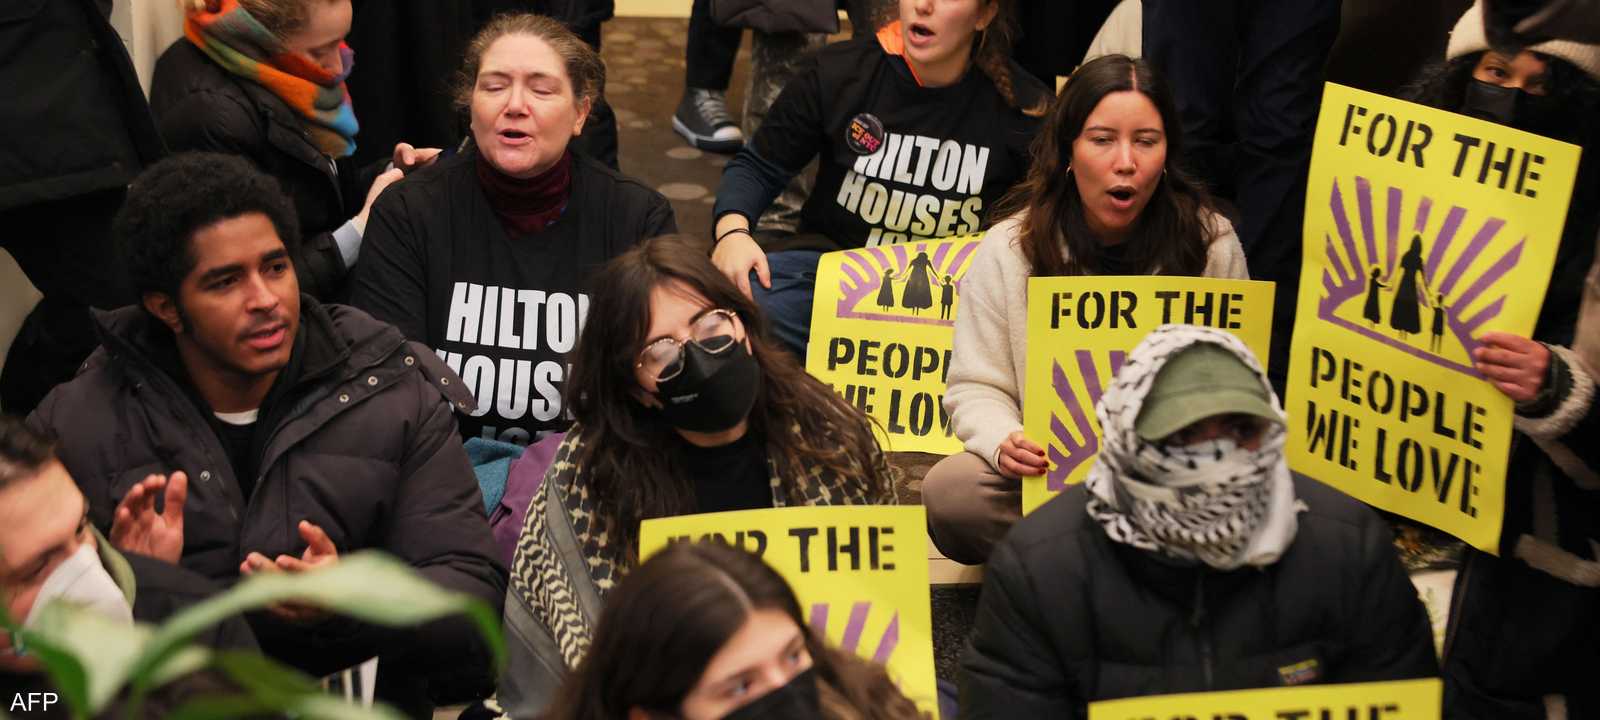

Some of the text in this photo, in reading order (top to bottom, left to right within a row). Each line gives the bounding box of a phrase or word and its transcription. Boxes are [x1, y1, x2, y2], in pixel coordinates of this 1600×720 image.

[1339, 103, 1546, 198] FOR THE
[837, 170, 982, 237] HOUSES
[1051, 291, 1244, 329] FOR THE
[435, 348, 577, 422] OUS
[827, 337, 953, 383] PEOP
[1311, 346, 1487, 450] PEOPLE
[1306, 400, 1482, 519] WE LOVE
[788, 527, 895, 573] THE
